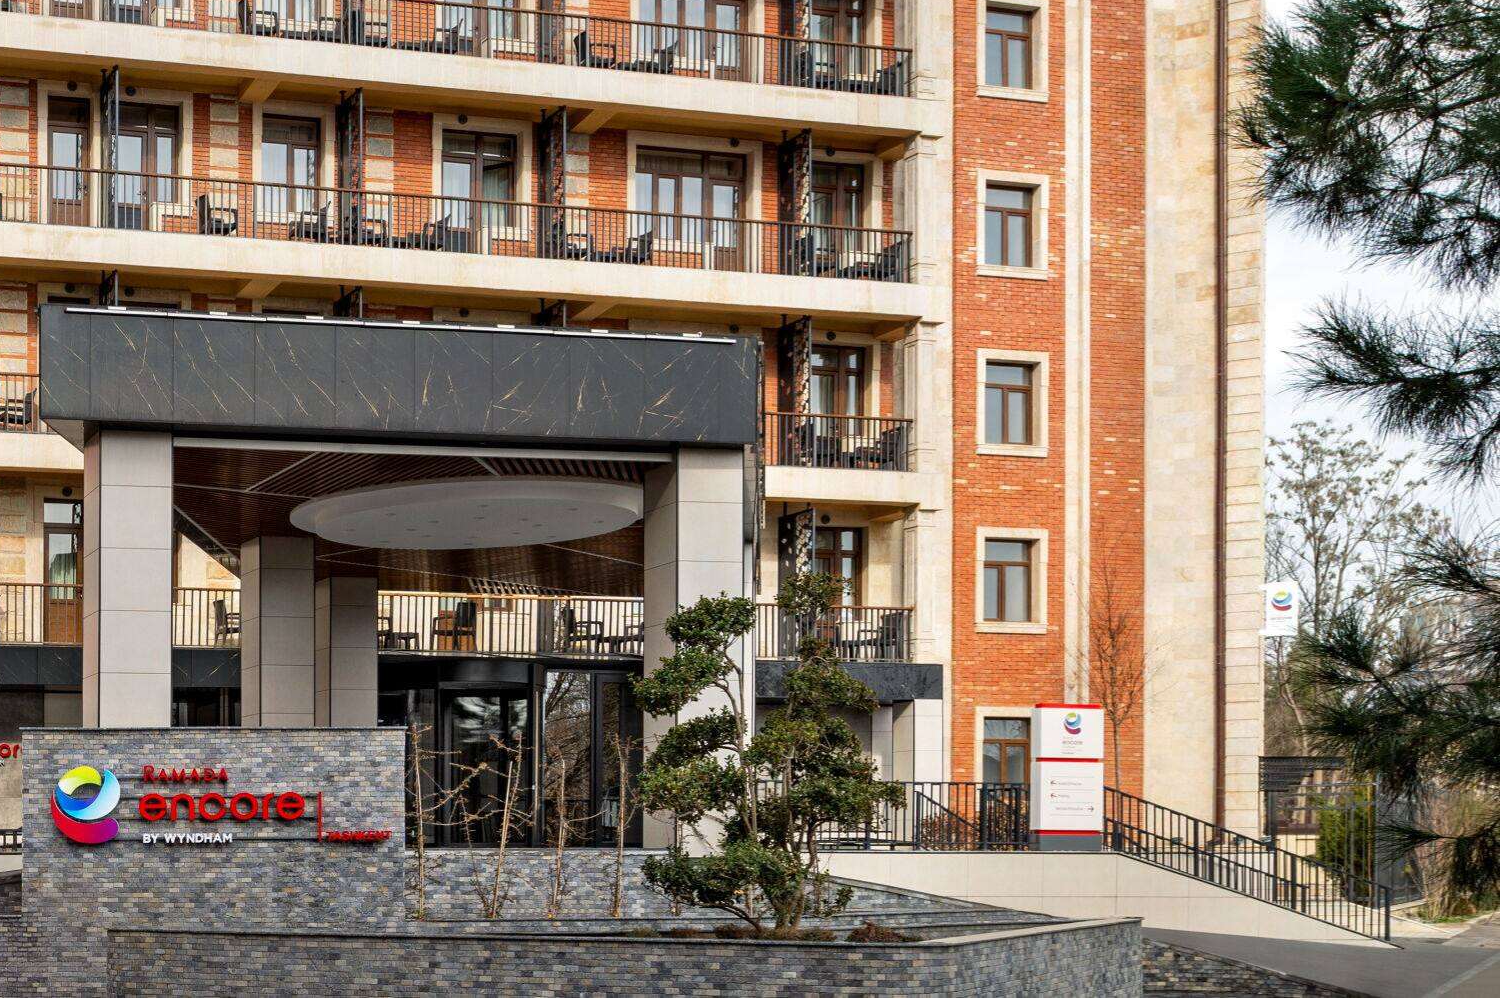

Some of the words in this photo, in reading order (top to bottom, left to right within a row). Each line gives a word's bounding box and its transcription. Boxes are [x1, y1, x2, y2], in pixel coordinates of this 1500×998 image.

[143, 765, 229, 782] RAMADA
[138, 792, 305, 822] encore
[142, 833, 159, 843] BY
[164, 832, 233, 843] WYNDHAM
[326, 830, 392, 842] TASHKENT
